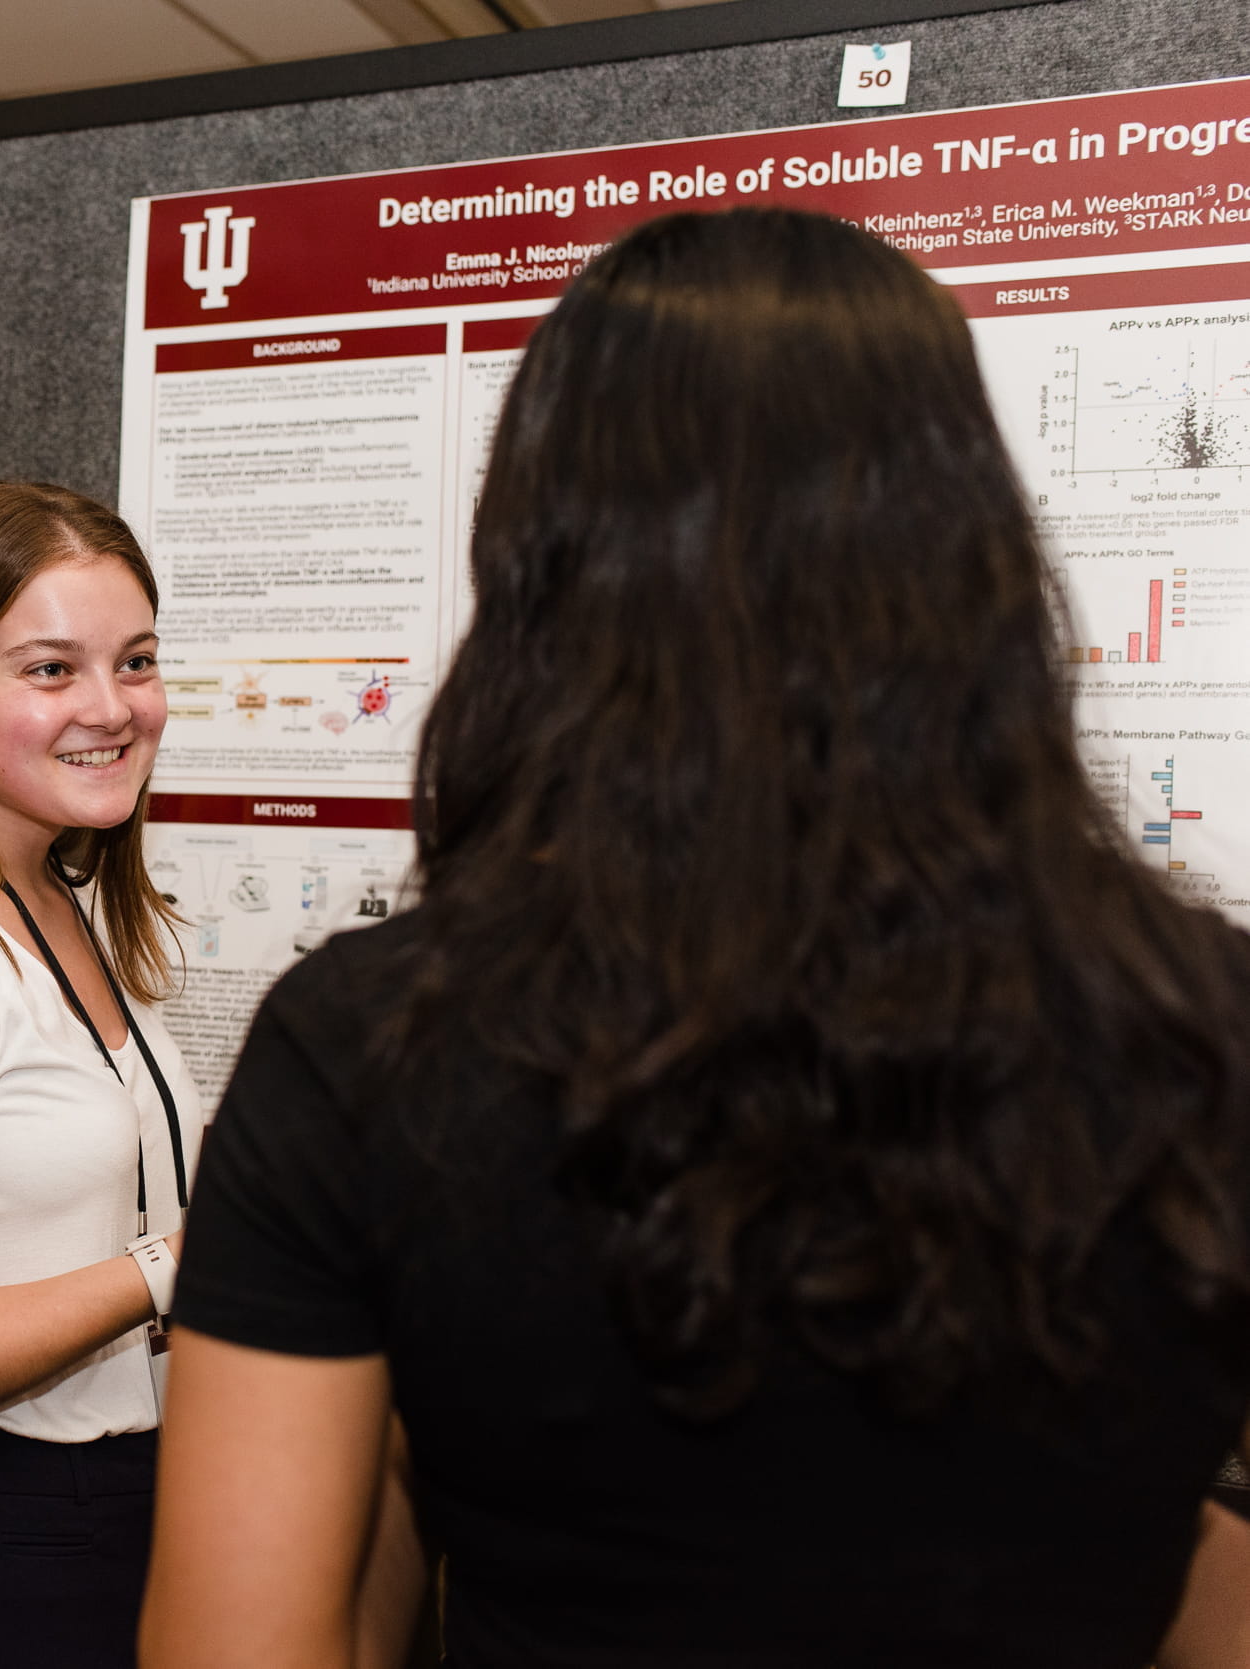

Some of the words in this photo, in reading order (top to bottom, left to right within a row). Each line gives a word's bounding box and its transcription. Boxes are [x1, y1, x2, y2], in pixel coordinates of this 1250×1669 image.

[857, 69, 892, 88] 50
[378, 183, 576, 227] Determining
[583, 175, 639, 208] the
[649, 165, 726, 202] Role
[736, 158, 776, 194] of
[782, 145, 922, 188] Soluble
[1068, 127, 1104, 161] in
[992, 205, 1045, 224] Erica
[1051, 199, 1078, 218] M.
[962, 222, 1014, 246] State
[1018, 216, 1120, 242] University,
[445, 251, 501, 271] Emma
[504, 248, 522, 266] J.
[432, 269, 510, 289] University
[513, 260, 570, 282] School
[995, 286, 1070, 305] RESULTS
[1109, 320, 1144, 331] APPv
[1147, 320, 1161, 329] vs
[1165, 317, 1200, 328] APPx
[252, 338, 341, 357] BACKGROUND
[1156, 491, 1178, 501] fold
[1180, 490, 1221, 502] change
[253, 802, 317, 818] METHODS
